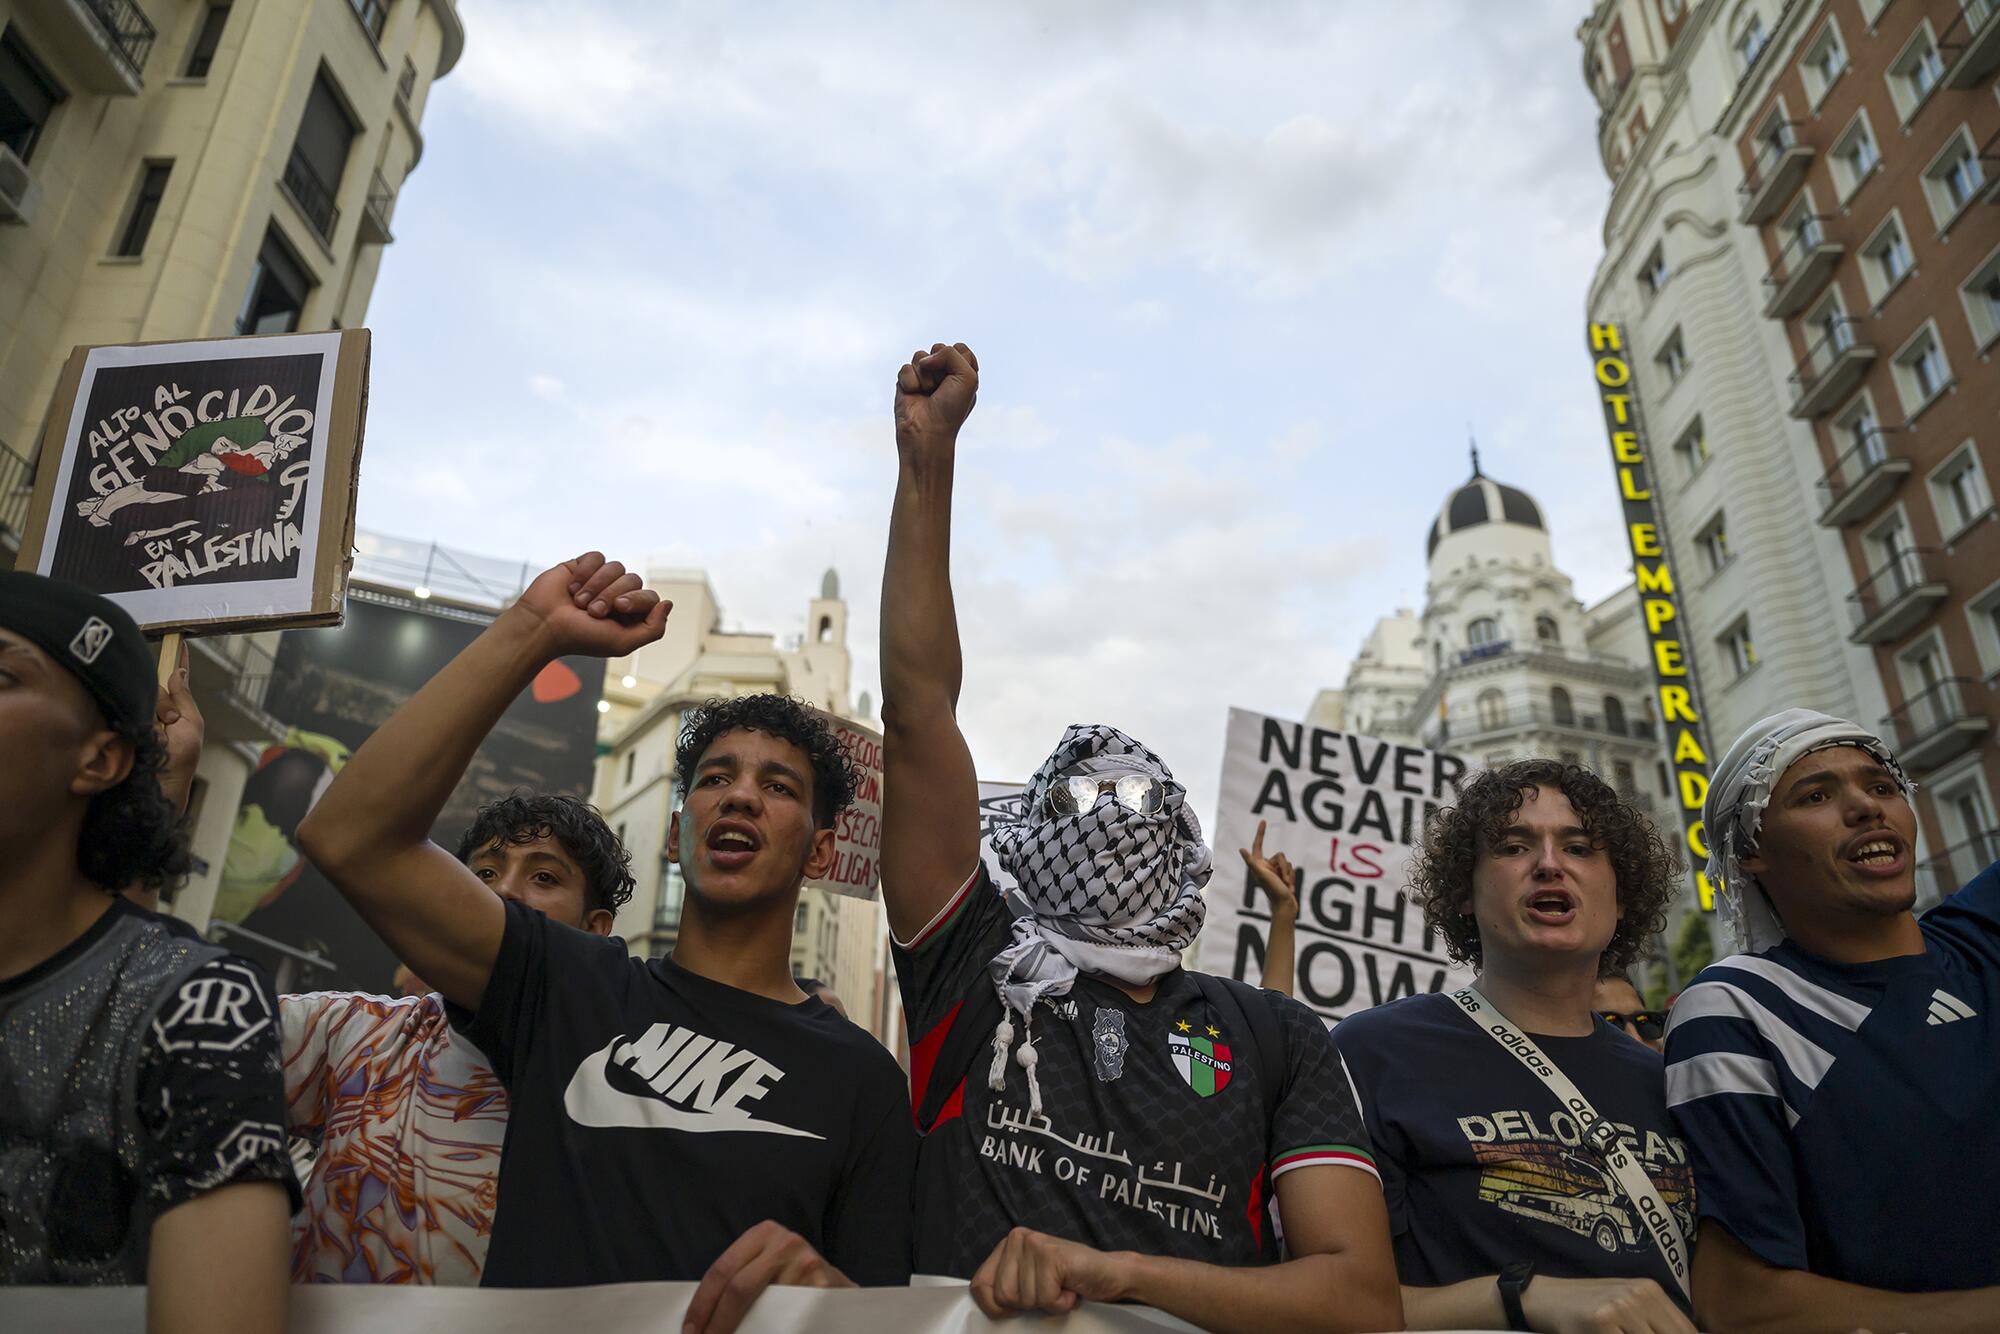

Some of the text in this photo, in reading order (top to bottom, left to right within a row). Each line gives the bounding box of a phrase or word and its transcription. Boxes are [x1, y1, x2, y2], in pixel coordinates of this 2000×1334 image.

[88, 383, 191, 458] ALTO AL
[89, 384, 314, 495] GENOCIDIO
[1590, 322, 1650, 500] HOTEL
[138, 521, 303, 588] PALESTINA
[144, 537, 173, 560] EN
[836, 727, 883, 773] RECOG
[1260, 717, 1467, 799] NEVER
[833, 808, 881, 851] SECH
[1329, 837, 1385, 879] IS
[613, 1022, 786, 1119] NIKE
[1172, 1045, 1231, 1073] PALESTINO
[1490, 1024, 1553, 1078] adidas
[980, 1135, 1045, 1175] BANK
[1054, 1156, 1091, 1186] OF
[1457, 1110, 1687, 1165] DELOEA
[1569, 1098, 1628, 1169] adds
[1638, 1195, 1685, 1279] adidas
